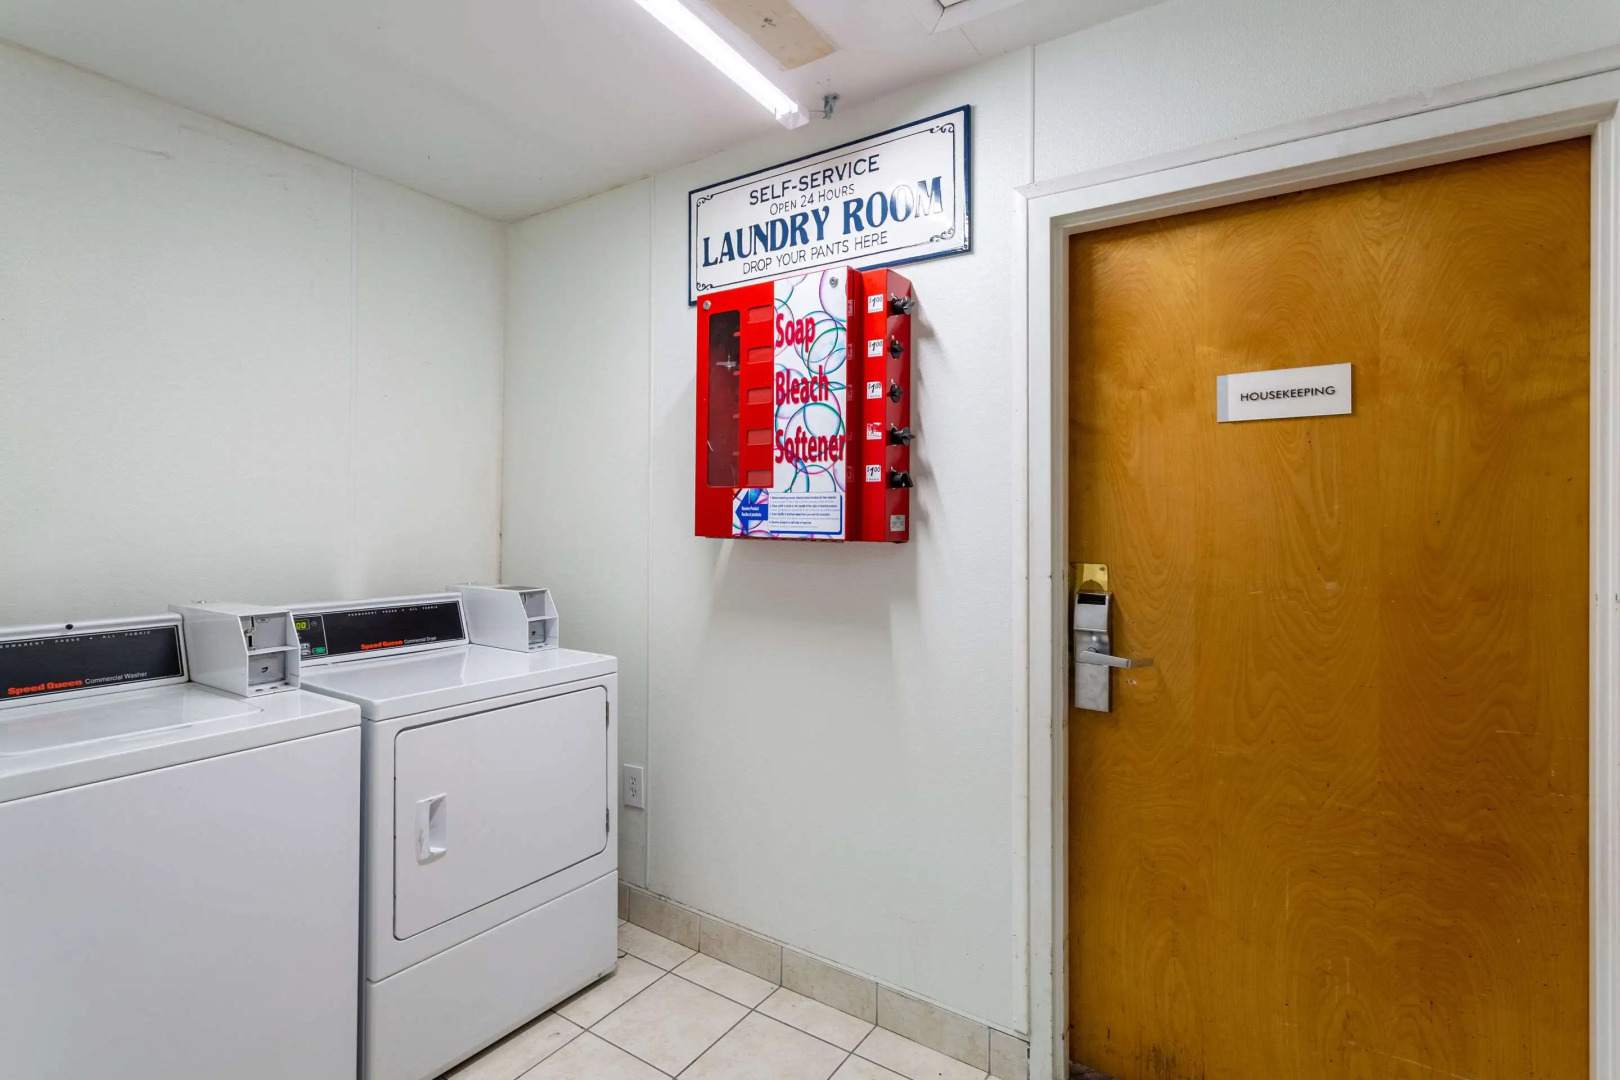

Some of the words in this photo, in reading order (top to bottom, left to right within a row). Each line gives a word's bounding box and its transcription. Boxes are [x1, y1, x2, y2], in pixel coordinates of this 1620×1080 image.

[749, 154, 880, 205] SELF-SERVICE
[769, 200, 797, 216] OPEN
[800, 194, 815, 208] 24
[818, 183, 855, 203] HOURS
[702, 206, 830, 268] LAUNDRY
[842, 176, 943, 235] ROOM
[742, 256, 772, 275] DROP
[776, 249, 808, 268] YOUR
[810, 239, 850, 260] PANTS
[854, 230, 888, 251] HERE
[775, 312, 816, 353] Soap
[775, 364, 829, 406] Bleach
[1240, 386, 1336, 401] HOUSEKEEPING
[775, 425, 846, 464] Softener
[360, 642, 382, 651] Speed
[382, 639, 404, 648] Queen
[8, 684, 45, 695] Speed
[47, 680, 83, 689] Queen
[85, 674, 123, 685] Commercial
[123, 671, 148, 680] Washer
